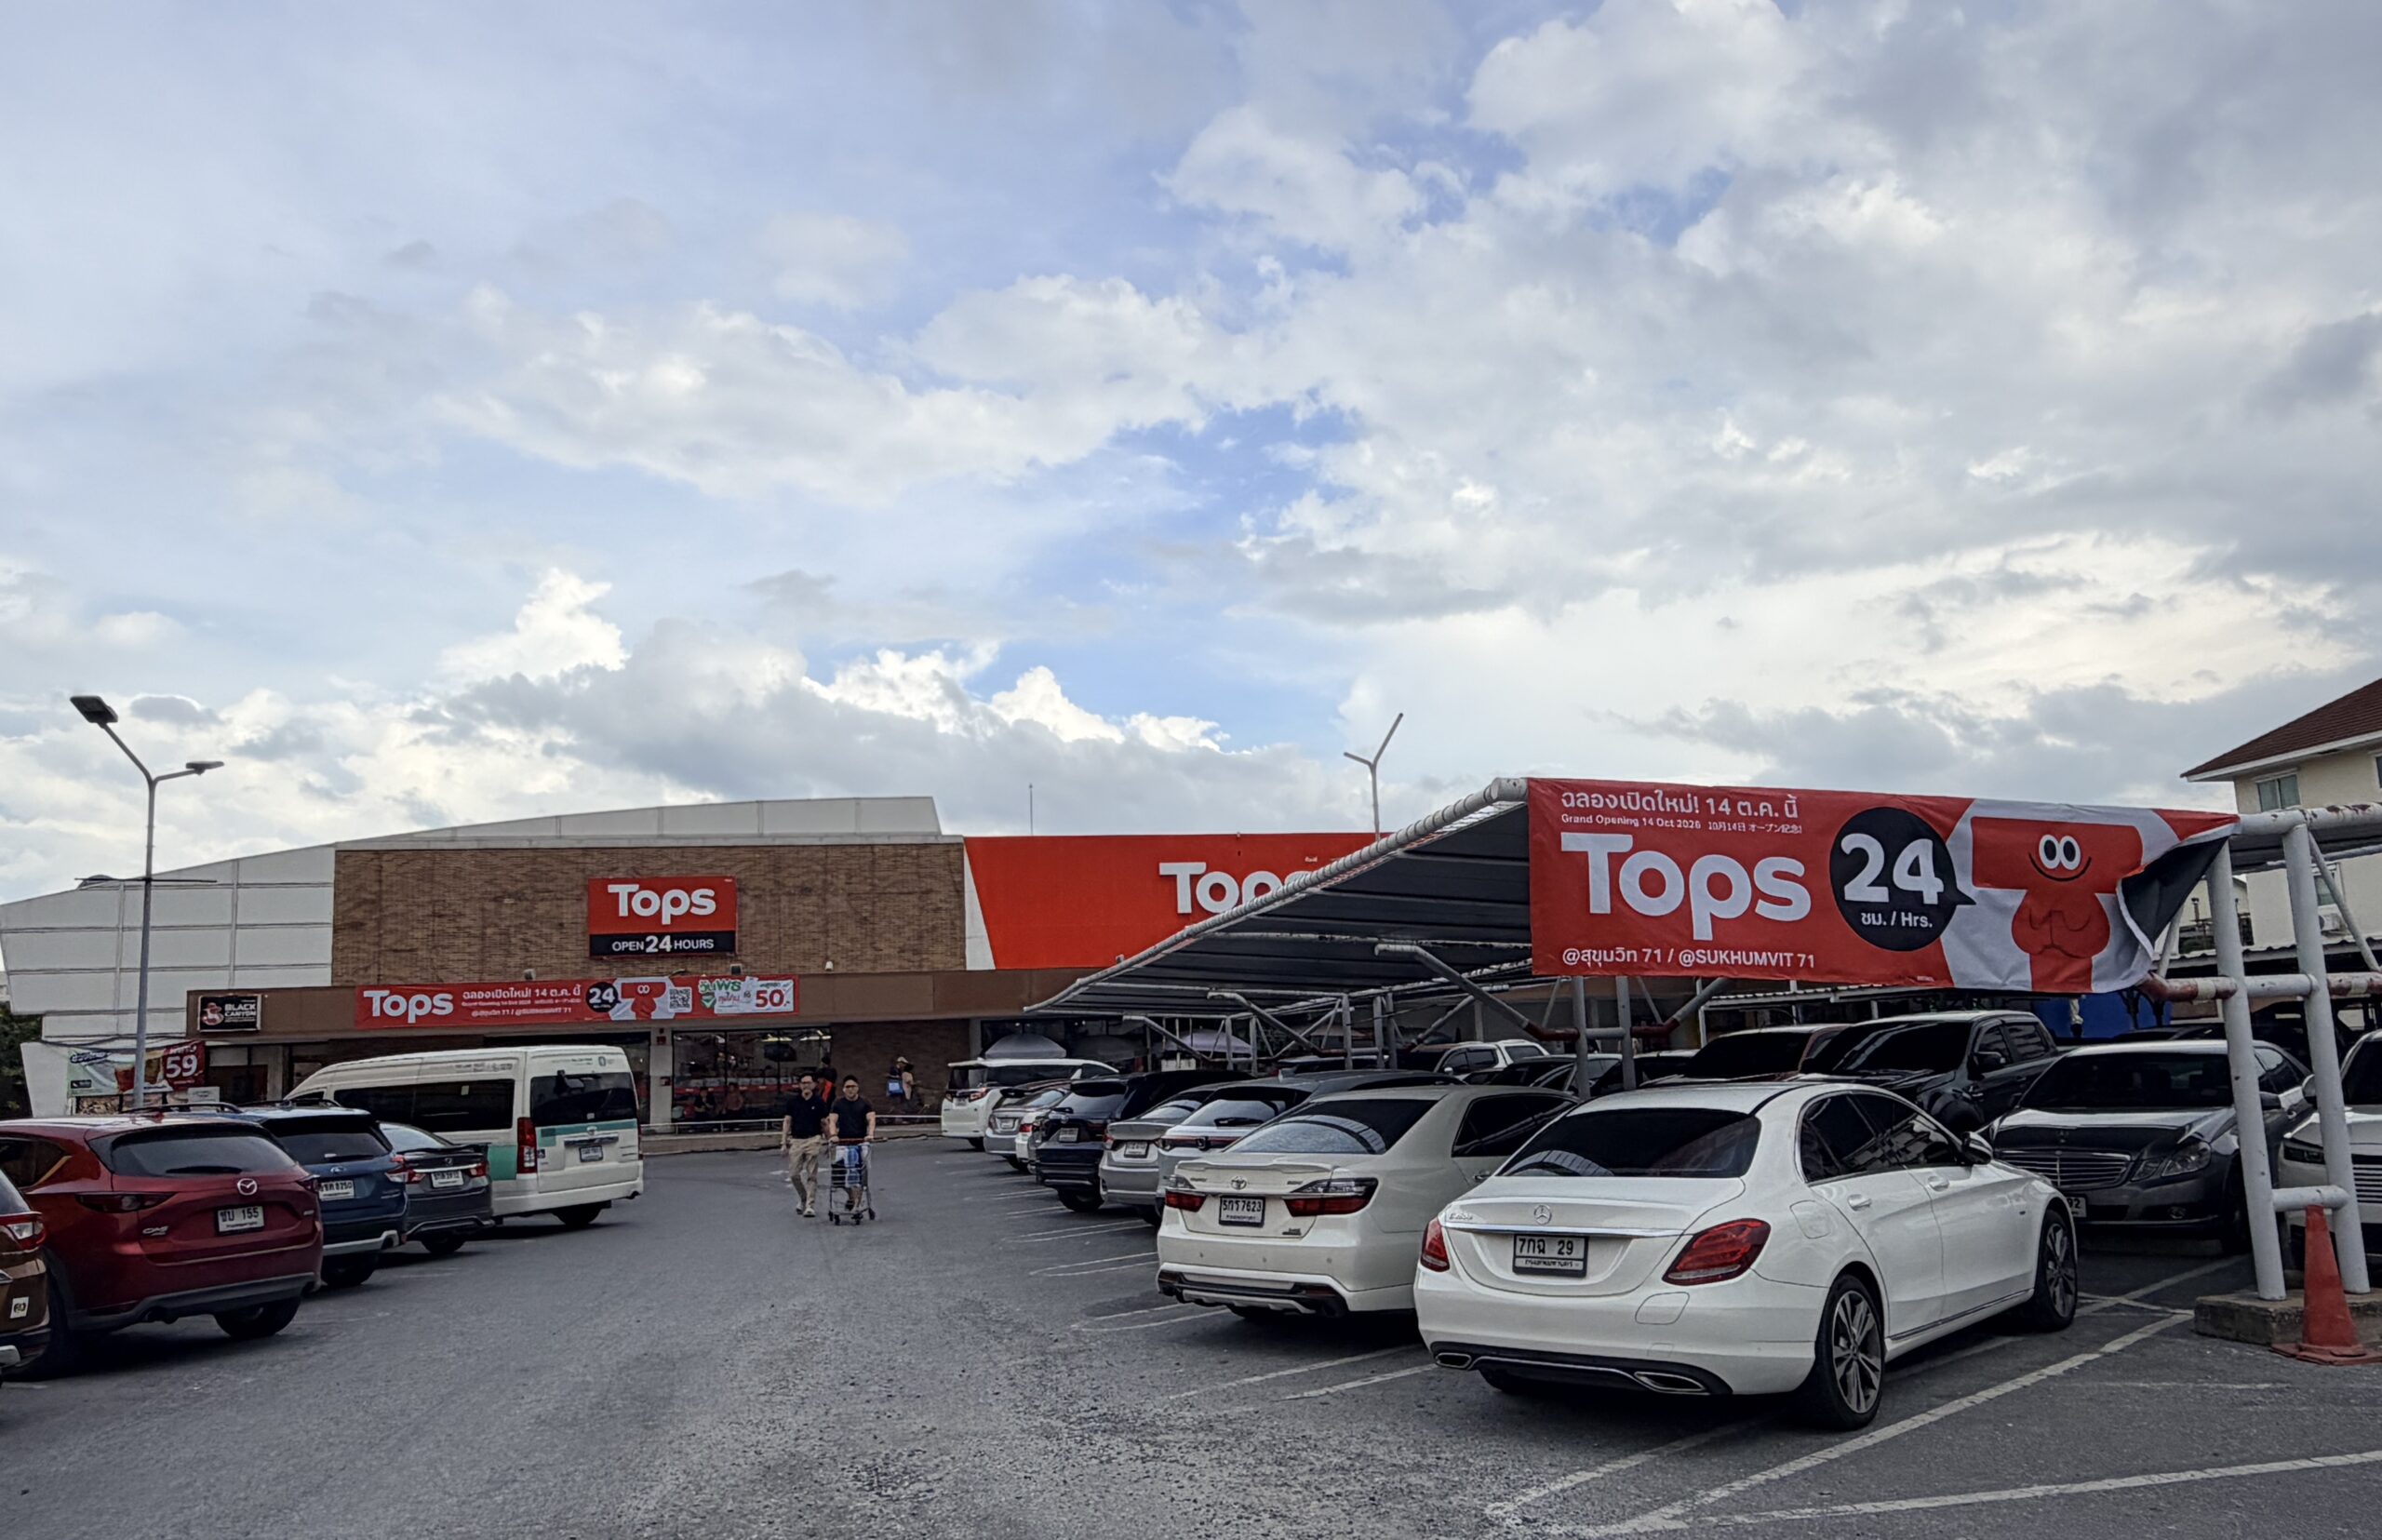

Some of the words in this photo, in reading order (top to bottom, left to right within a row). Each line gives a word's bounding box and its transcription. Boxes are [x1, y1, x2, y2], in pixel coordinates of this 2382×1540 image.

[1561, 789, 1700, 814] ฉลองเปิดใหม่!
[1706, 797, 1731, 815] 14
[1737, 801, 1779, 817] ต.ค.
[1785, 794, 1798, 818] นี้
[1561, 813, 1593, 824] Grand
[1596, 814, 1639, 827] Opening
[1642, 818, 1653, 826] 14
[1656, 818, 1675, 828] Oct
[1840, 833, 1945, 904] 24
[1560, 831, 1812, 941] Tops
[608, 884, 716, 926] Tops
[1861, 912, 1887, 926] ชม.
[1891, 911, 1897, 926] /
[1901, 912, 1934, 928] Hrs.
[611, 941, 644, 952] OPEN
[645, 935, 672, 953] 24
[674, 939, 715, 950] HOURS
[1641, 948, 1661, 963] 71
[1666, 948, 1675, 963] /
[1679, 949, 1794, 968] @SUKHUMVIT
[1797, 954, 1815, 968] 71
[534, 988, 547, 997] 14
[589, 987, 615, 1004] 24
[363, 989, 454, 1024] Tops
[241, 1207, 260, 1221] 155
[1240, 1199, 1262, 1212] 7623
[1557, 1239, 1574, 1255] 29
